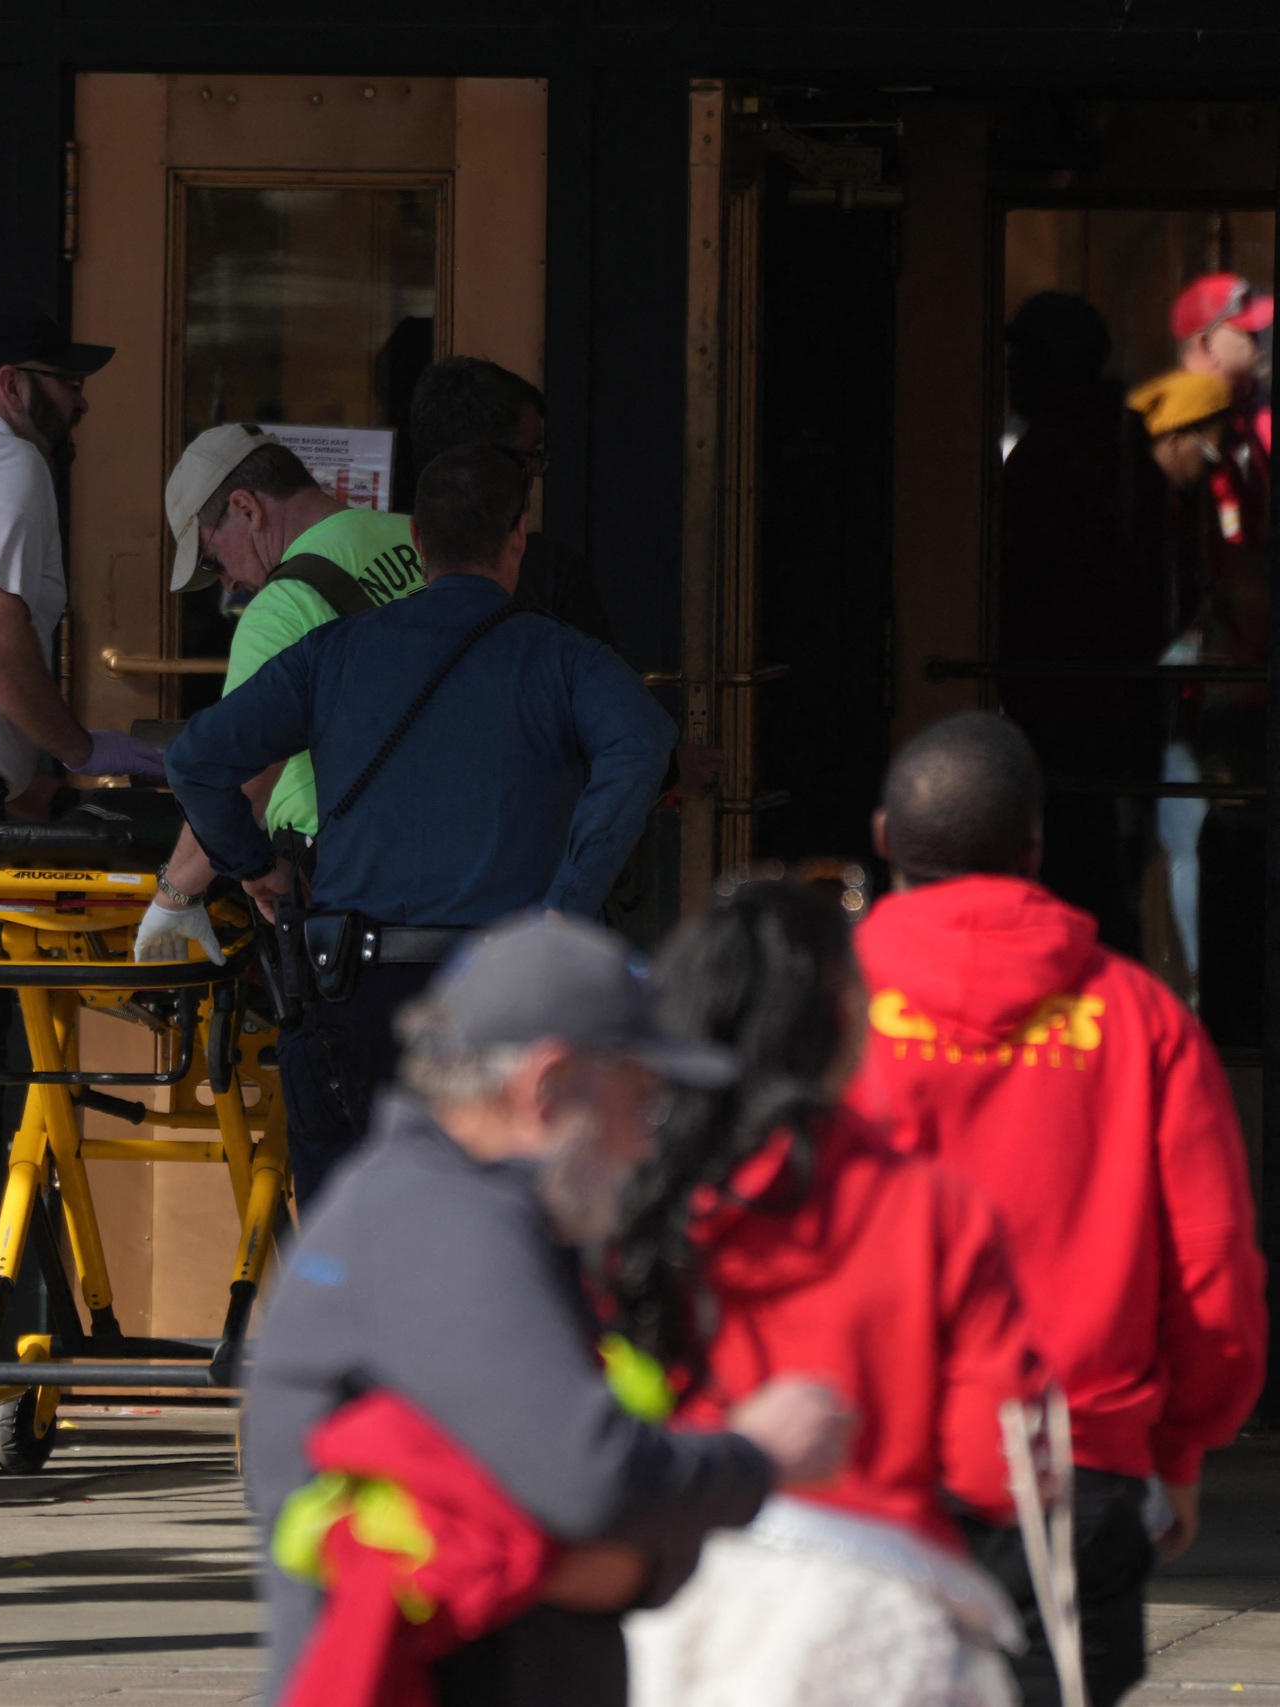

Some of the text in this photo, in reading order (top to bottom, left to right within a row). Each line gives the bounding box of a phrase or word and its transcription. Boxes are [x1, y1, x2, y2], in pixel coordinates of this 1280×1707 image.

[302, 438, 329, 446] BADGES
[330, 439, 349, 447] HAVE
[20, 871, 86, 880] RUGGED
